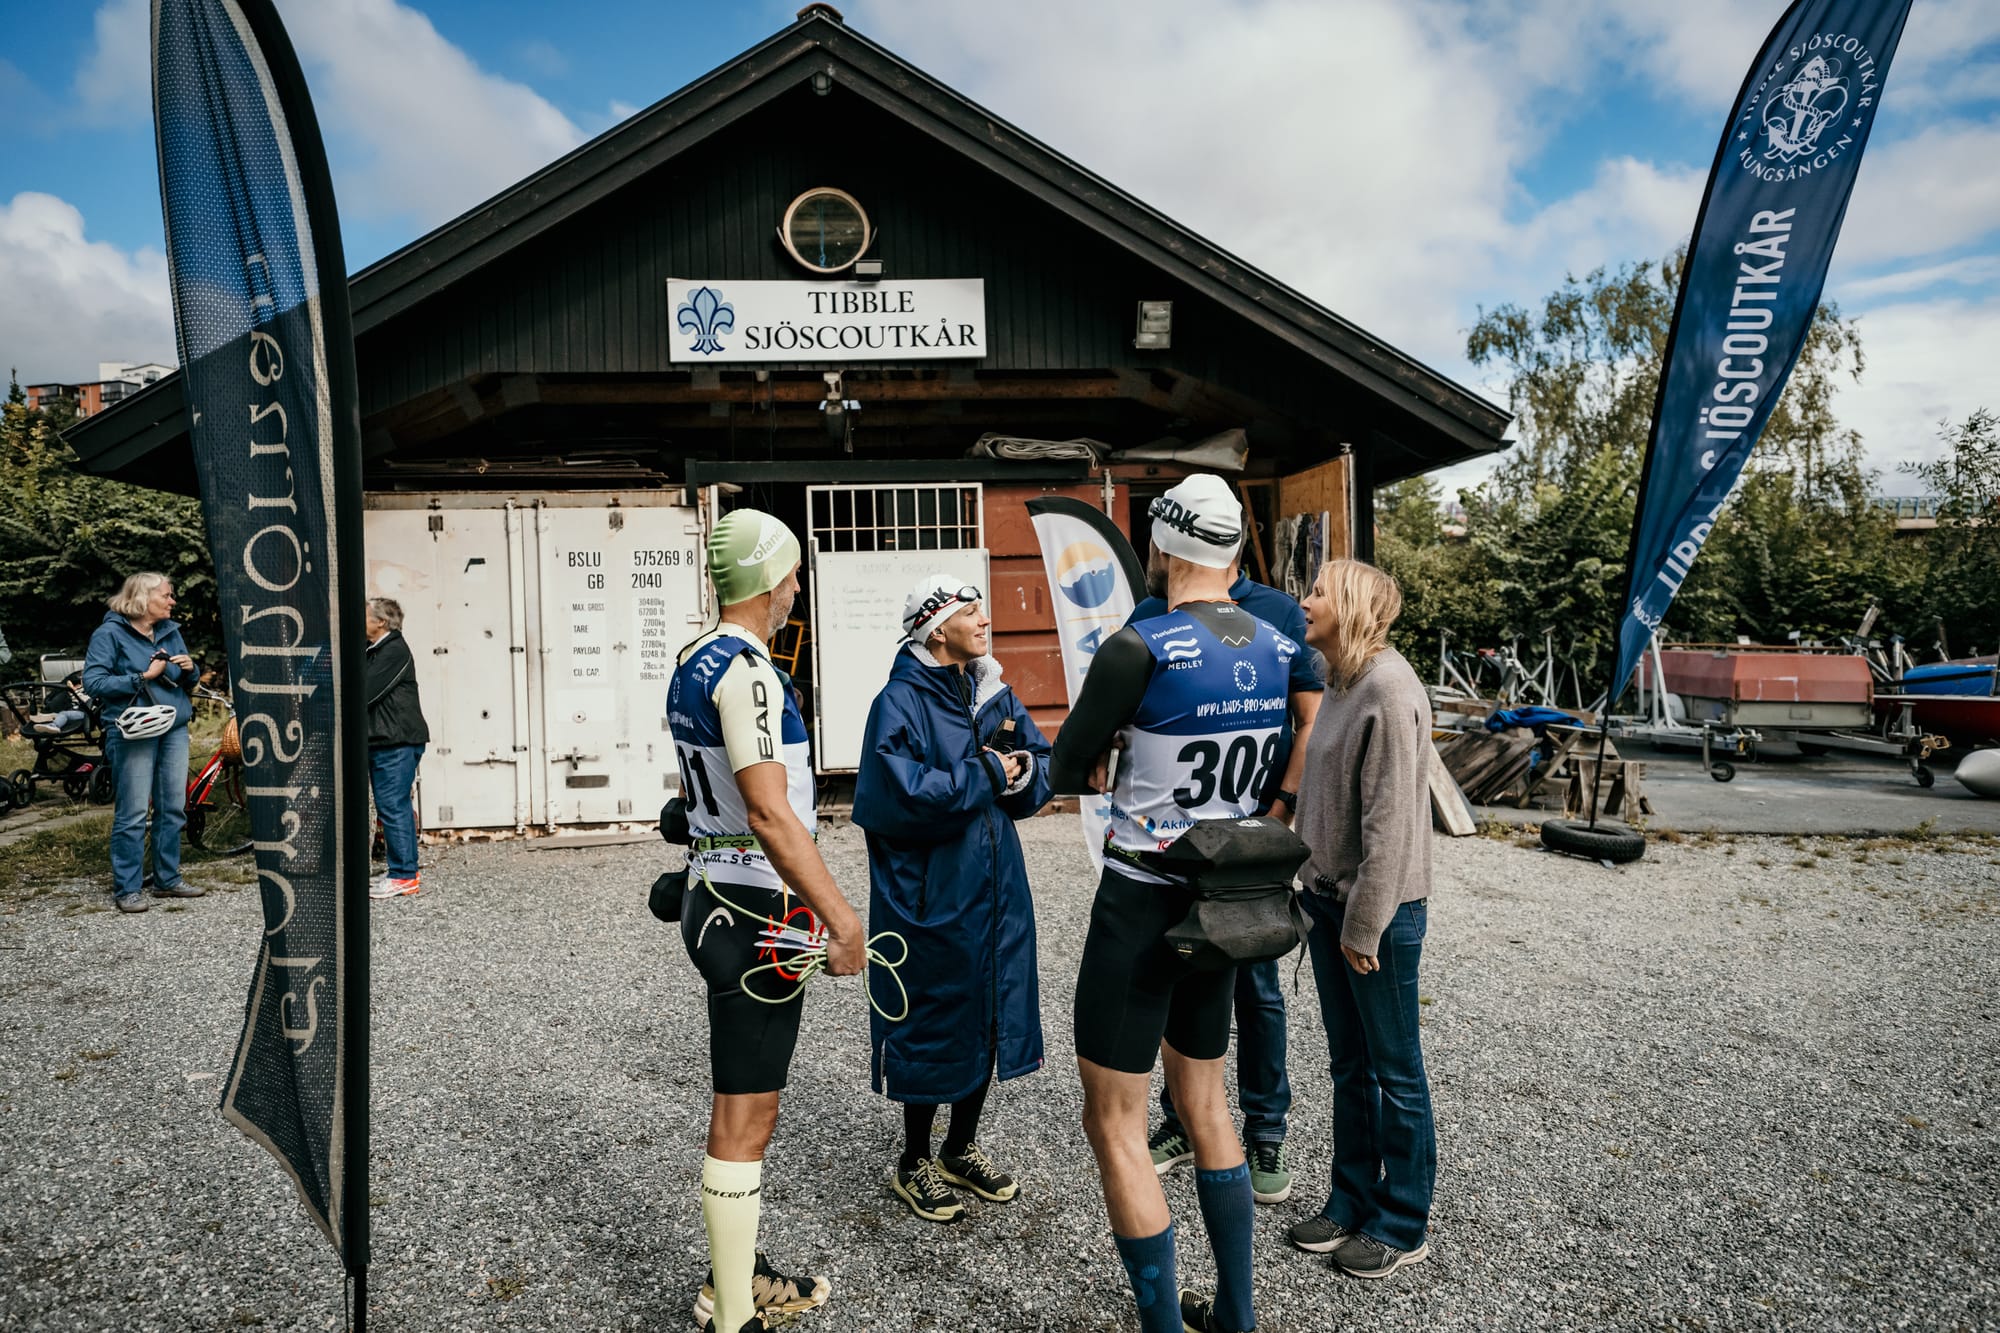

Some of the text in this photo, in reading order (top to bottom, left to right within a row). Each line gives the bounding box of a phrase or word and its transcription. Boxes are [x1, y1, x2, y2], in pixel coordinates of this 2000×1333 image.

[1790, 33, 1879, 108] SJÖSCOUTKÅR
[1739, 134, 1853, 182] KUNGSÄNGEN
[808, 291, 915, 314] TIBBLE
[745, 318, 979, 350] SJÖSCOUTKÅR
[568, 550, 694, 567] BSLU 575269 8
[587, 573, 662, 589] GB 2040
[573, 624, 588, 633] TARE
[643, 618, 666, 628] 2700kg
[642, 628, 658, 637] 5952
[573, 646, 601, 655] PAYLOAD
[1167, 659, 1203, 670] MEDLEY
[1173, 732, 1279, 809] 308
